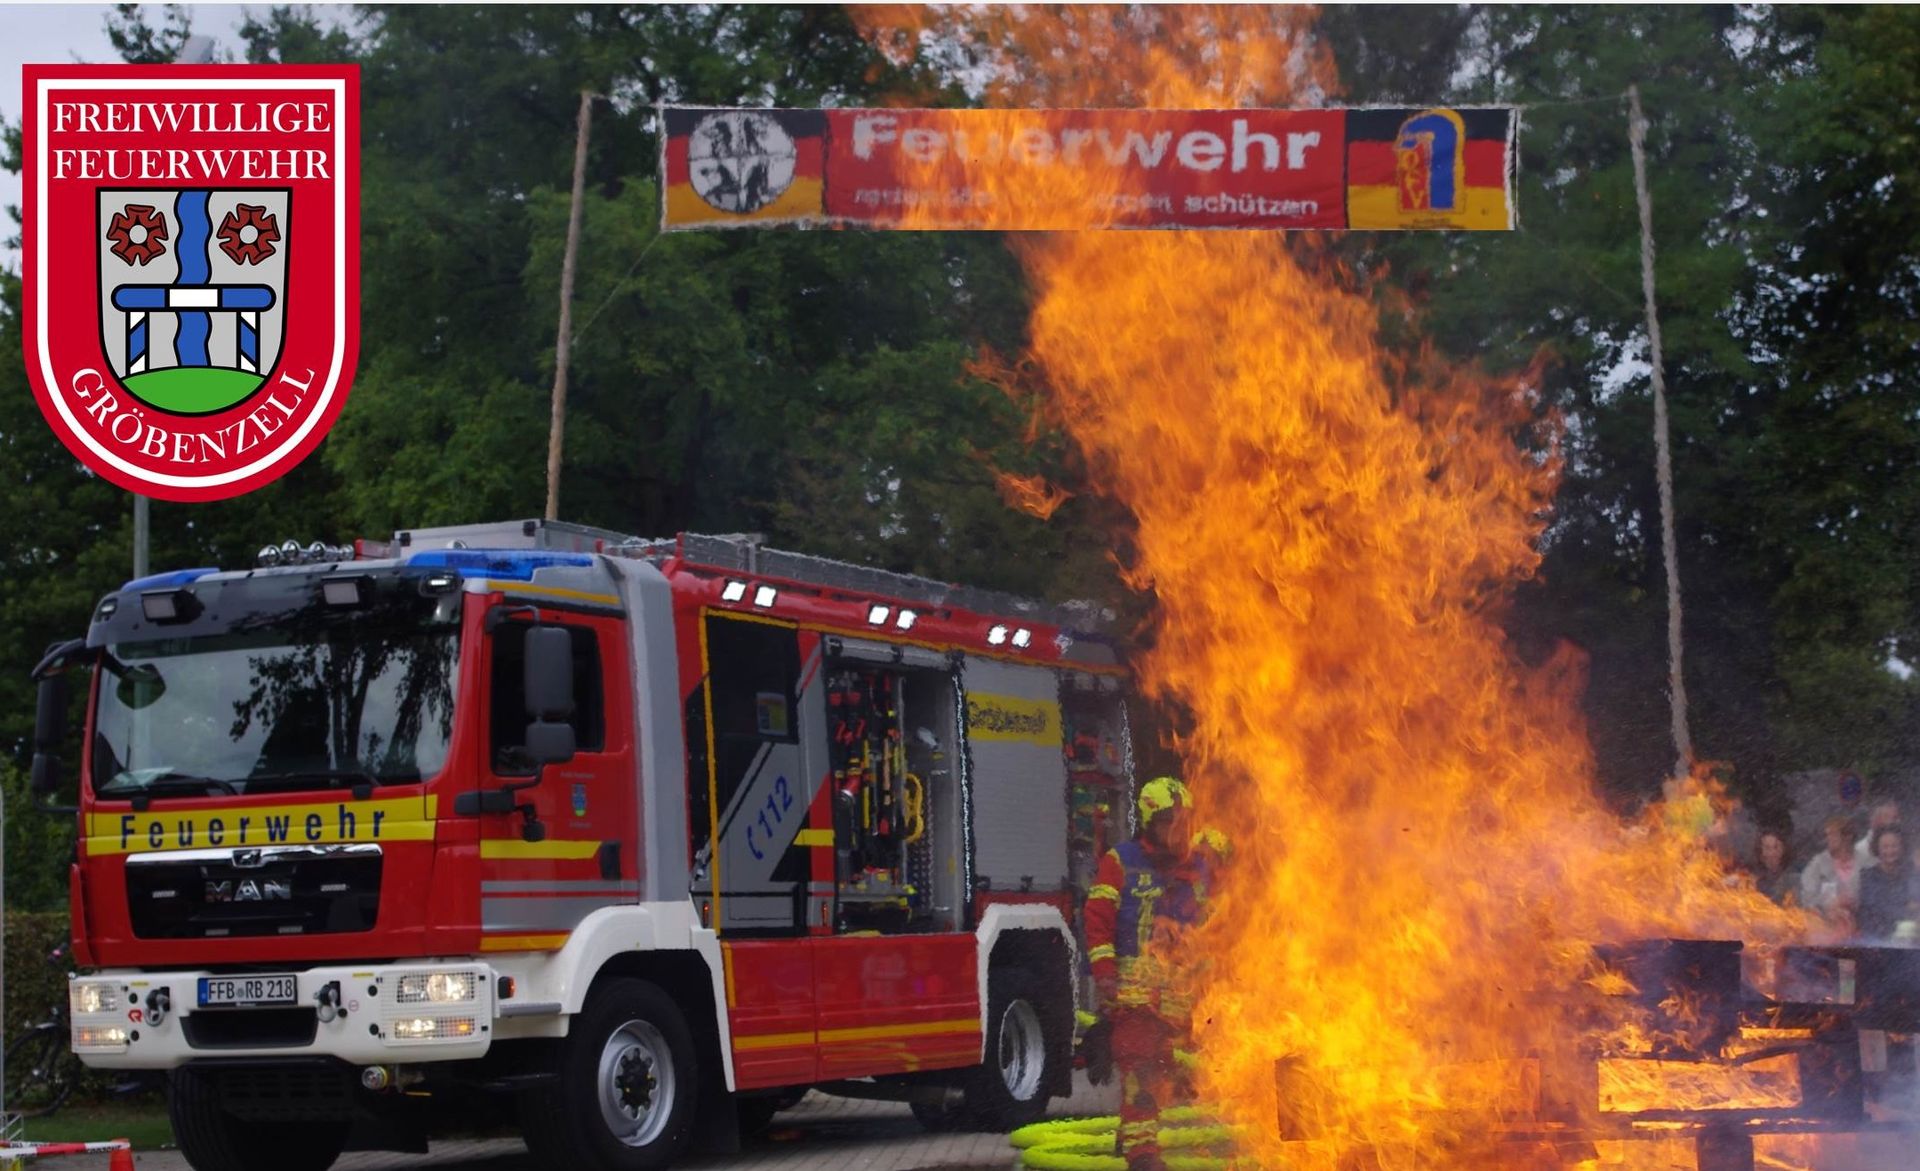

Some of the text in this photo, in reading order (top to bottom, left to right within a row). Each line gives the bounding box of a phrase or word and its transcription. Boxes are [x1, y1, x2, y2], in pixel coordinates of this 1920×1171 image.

[852, 113, 1321, 173] Feuerwehr
[120, 803, 386, 850] Feuerwehr
[758, 775, 793, 839] 112
[205, 879, 292, 902] MAN
[208, 979, 294, 1001] FFB RB 218
